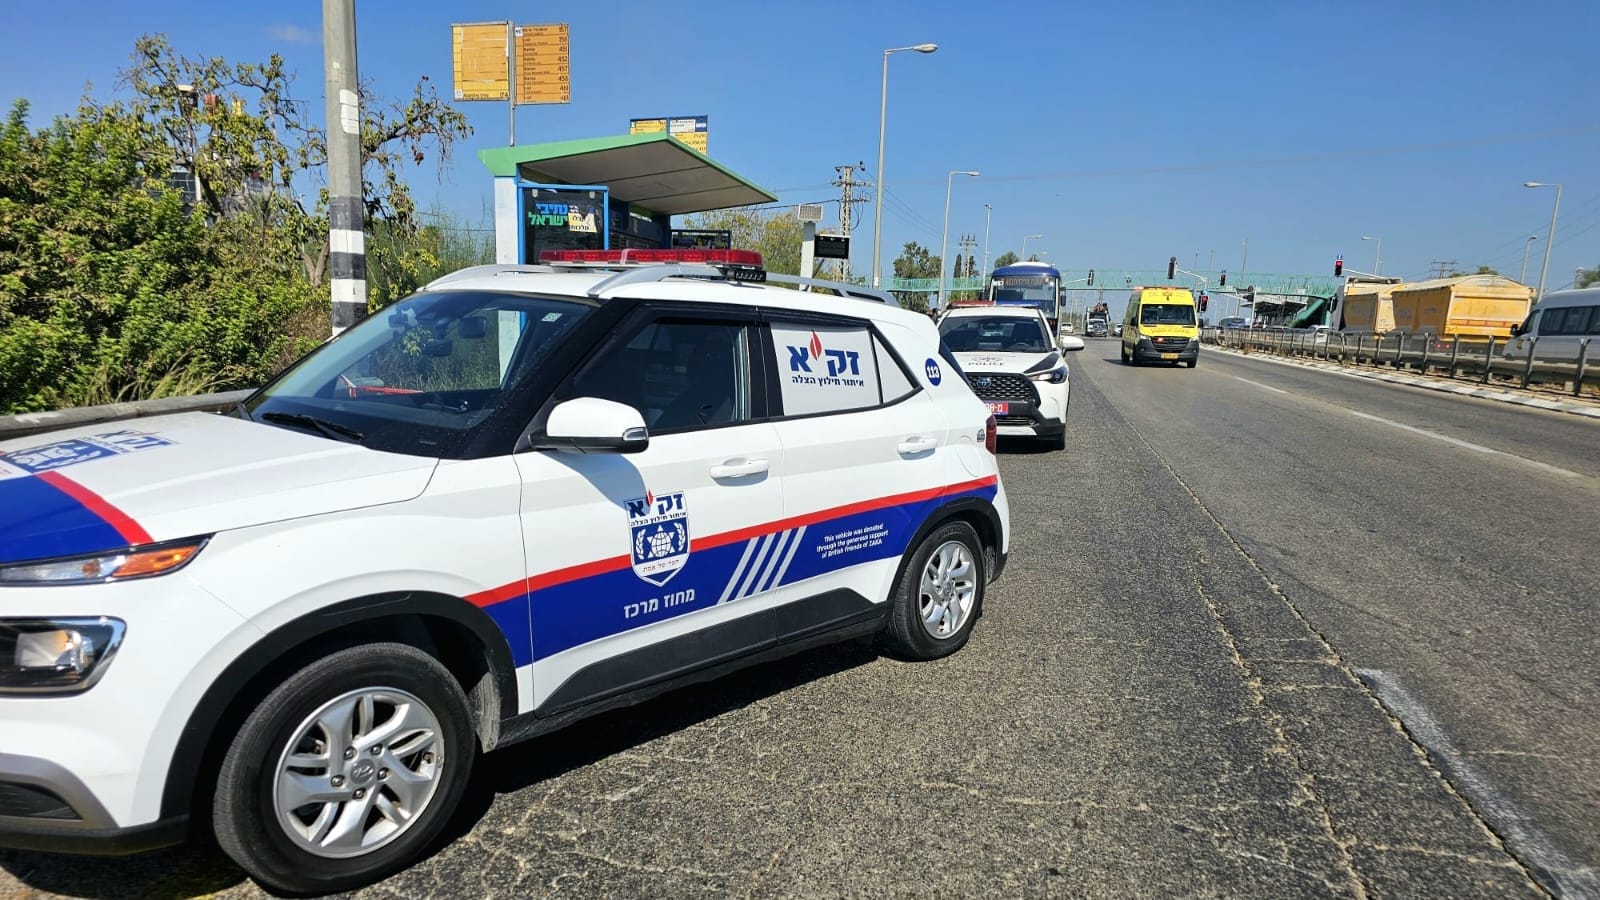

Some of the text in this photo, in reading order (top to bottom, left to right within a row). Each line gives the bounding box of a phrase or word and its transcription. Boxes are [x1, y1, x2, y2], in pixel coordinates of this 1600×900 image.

[536, 203, 568, 214] נתיבי
[528, 211, 569, 226] ישראל
[926, 365, 939, 378] 113
[792, 375, 864, 387] איתור חילוץ הצלה
[630, 518, 648, 527] הצלה
[816, 542, 836, 552] through
[846, 534, 868, 545] generous
[869, 529, 888, 539] support
[824, 535, 834, 543] This
[835, 530, 852, 540] vehicle
[863, 523, 884, 533] donated
[827, 547, 844, 557] British
[844, 543, 862, 552] Friends
[868, 538, 883, 547] ZAKA
[623, 588, 695, 619] מחוז מרכז
